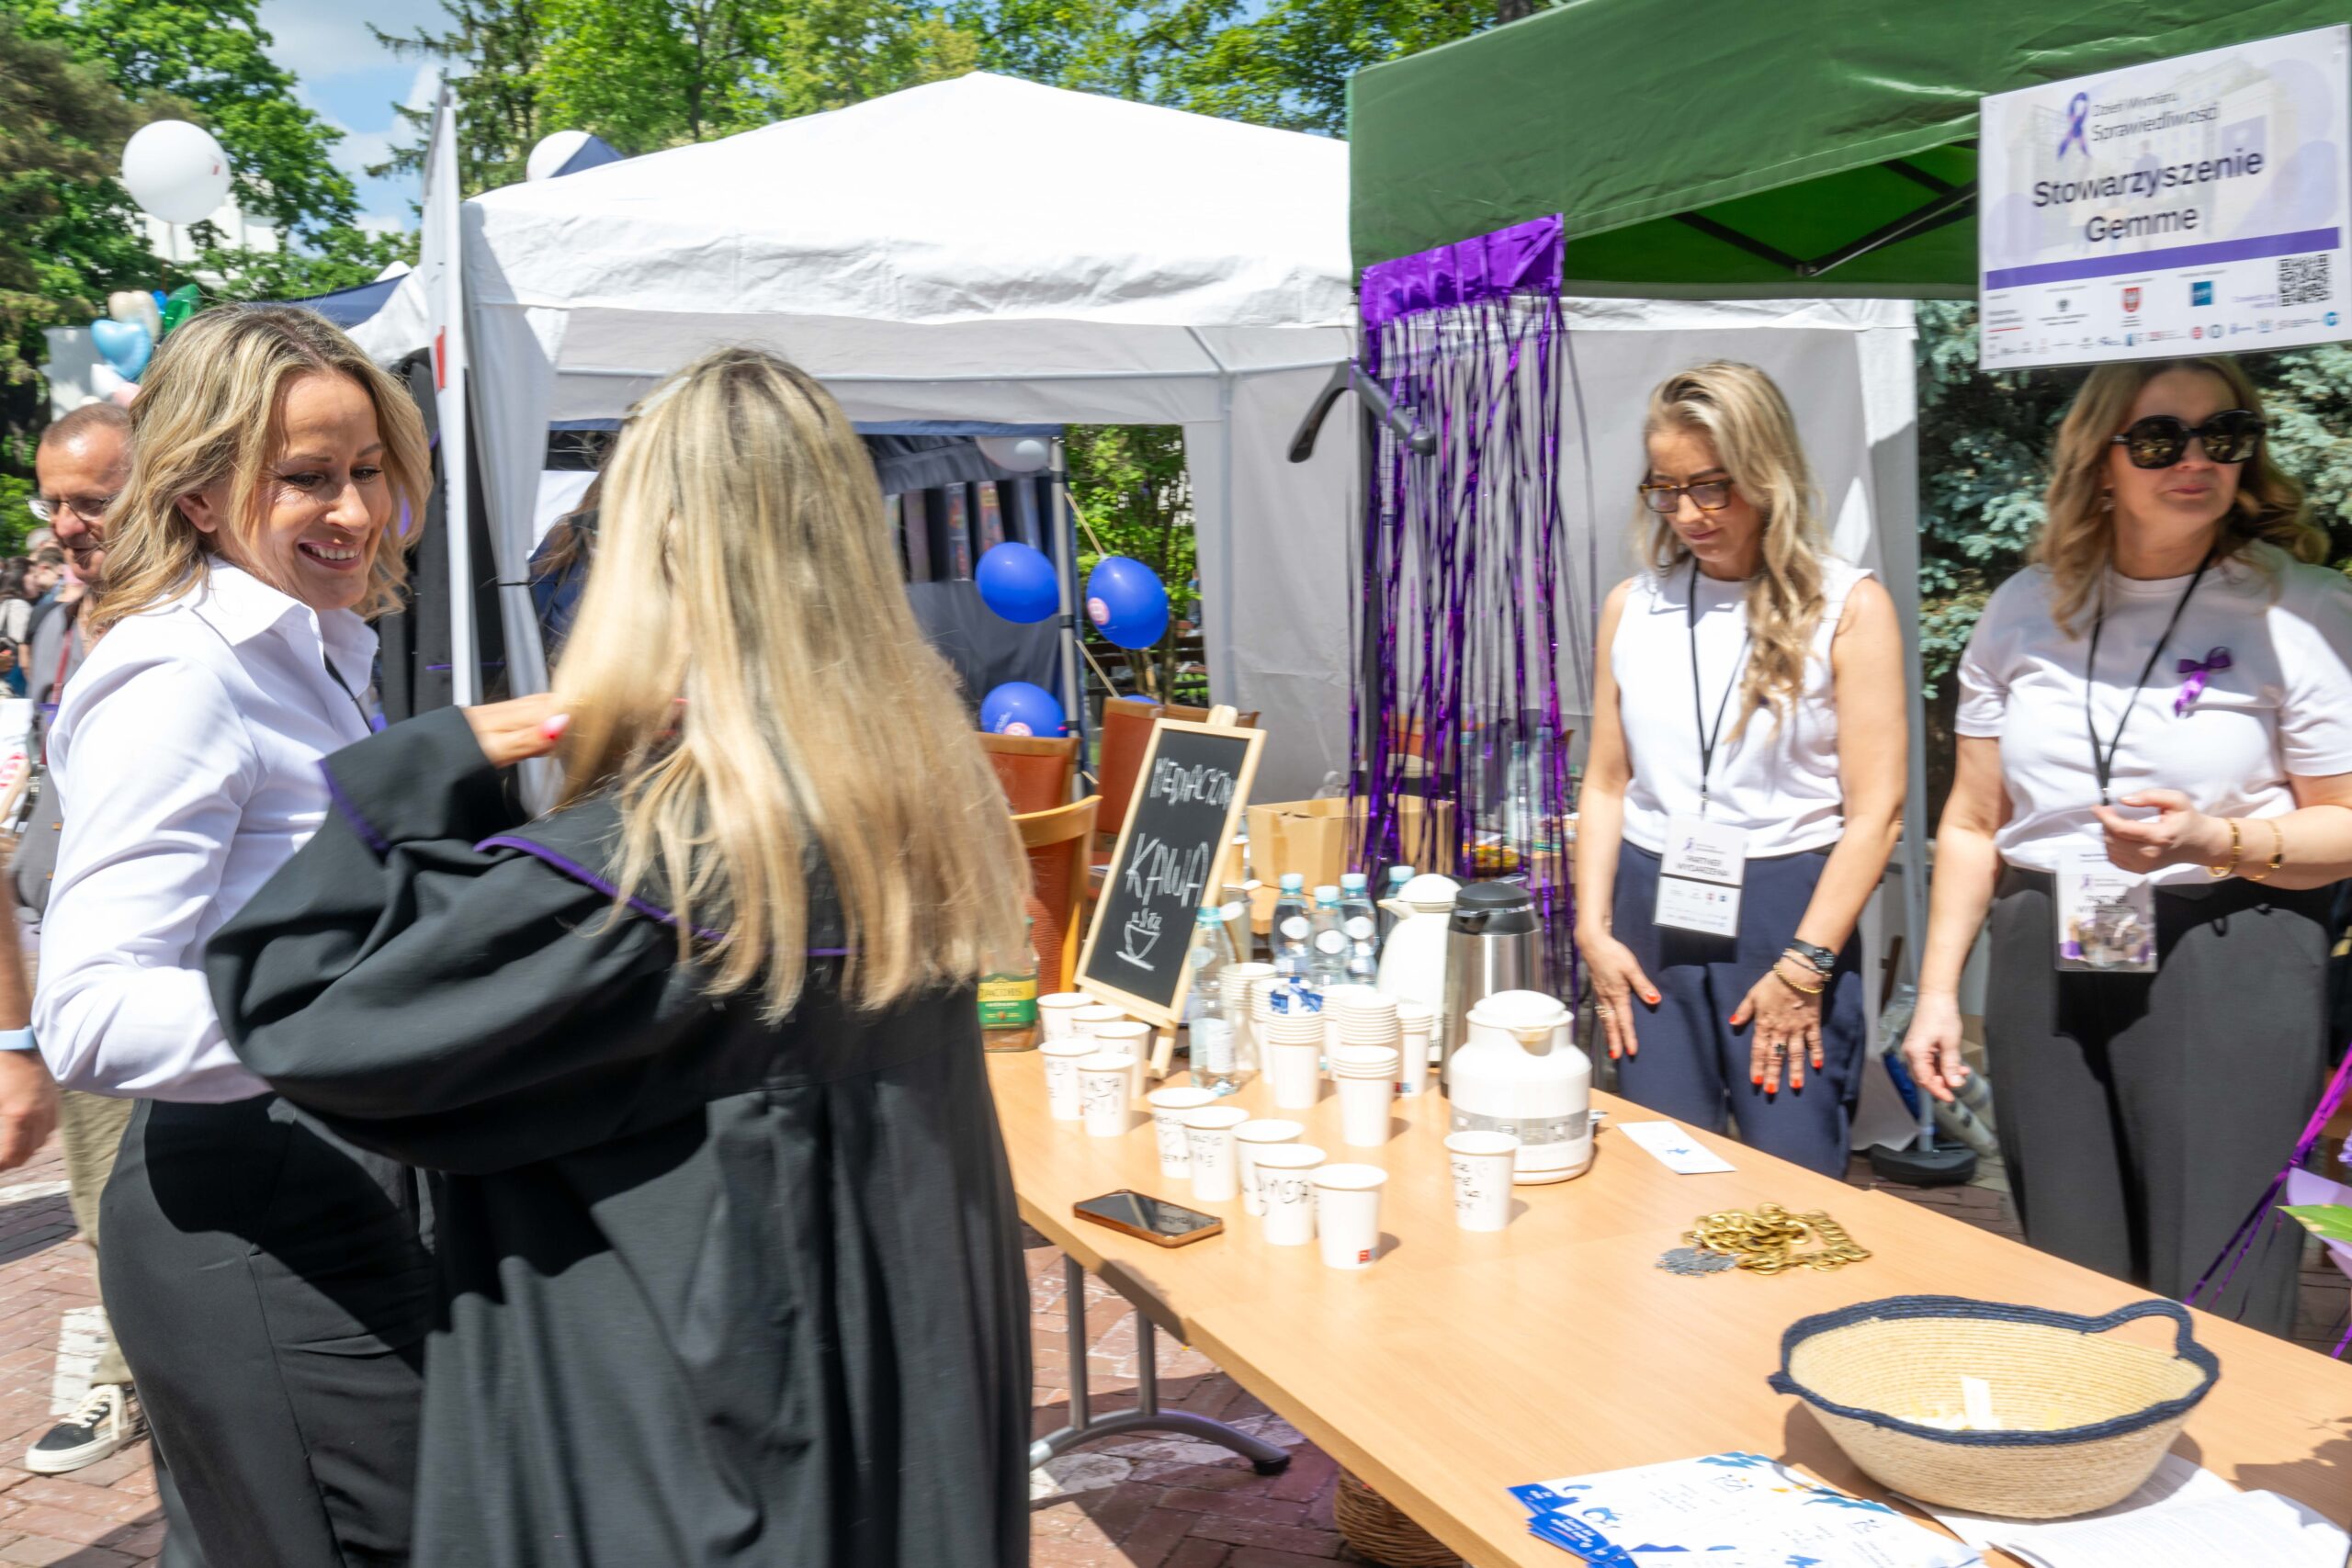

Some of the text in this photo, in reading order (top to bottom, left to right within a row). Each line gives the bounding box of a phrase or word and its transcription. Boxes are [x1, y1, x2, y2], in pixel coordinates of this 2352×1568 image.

[2091, 101, 2222, 142] Sprawiedliwości
[2031, 148, 2266, 209] Stowarzyszenie
[2085, 208, 2200, 243] Gemme
[1125, 832, 1210, 908] KAWA
